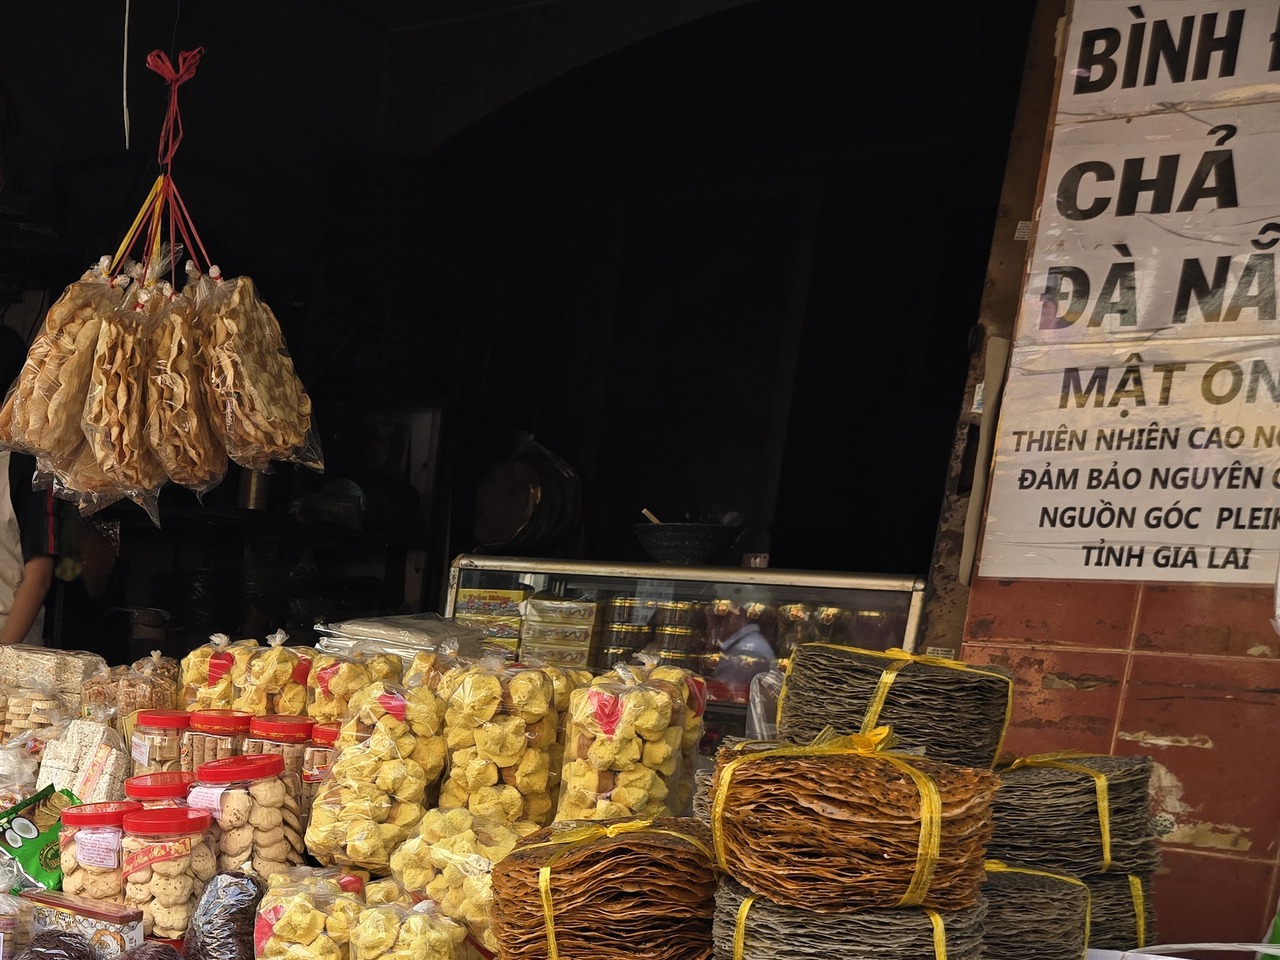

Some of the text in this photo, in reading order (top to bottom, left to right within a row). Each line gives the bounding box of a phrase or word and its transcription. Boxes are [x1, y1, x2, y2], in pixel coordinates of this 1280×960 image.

[1073, 5, 1246, 95] BÌNH
[1056, 124, 1239, 221] CHẢ
[1039, 243, 1138, 331] ĐÀ
[1058, 352, 1187, 418] MẬT
[1012, 423, 1087, 452] THIÊN
[1094, 421, 1180, 451] NHIÊN
[1187, 425, 1245, 450] CAO
[1017, 462, 1079, 490] ĐẢM
[1086, 460, 1142, 490] BẢO
[1149, 459, 1264, 490] NGUYÊN
[1039, 499, 1137, 529] NGUỒN
[1144, 500, 1201, 530] GÓC
[1081, 538, 1253, 570] TỈNH GIA LAI
